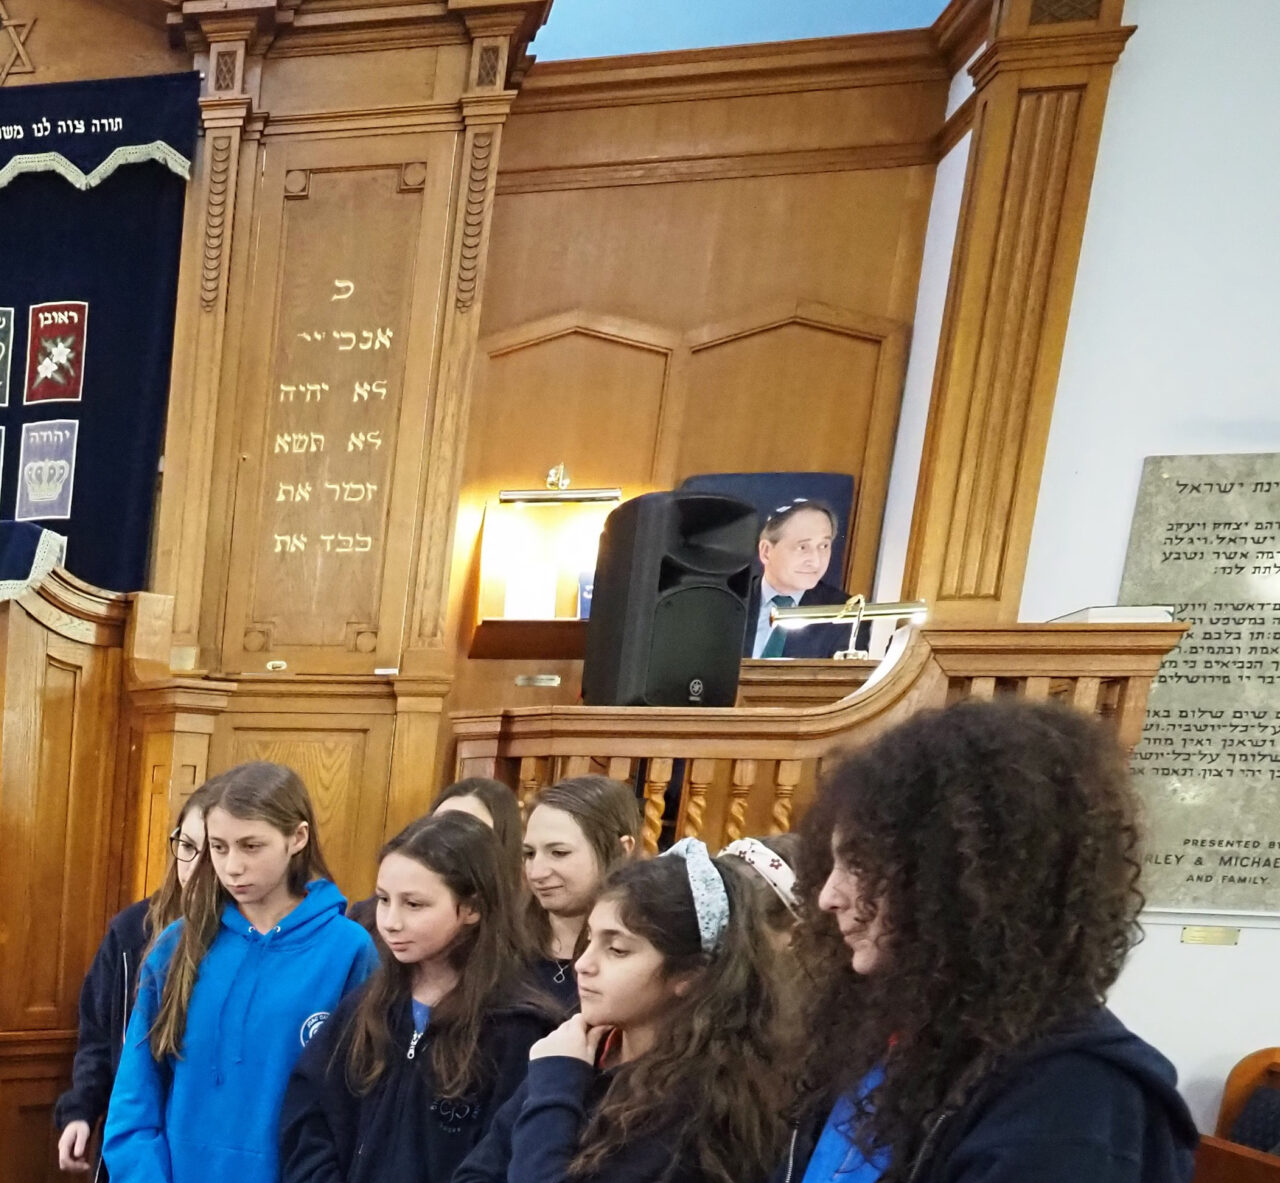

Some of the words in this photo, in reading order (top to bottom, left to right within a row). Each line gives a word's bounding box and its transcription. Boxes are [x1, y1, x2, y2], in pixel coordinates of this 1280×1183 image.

[32, 116, 52, 138] לנו
[58, 119, 85, 135] צוה
[91, 116, 123, 133] תורה
[39, 310, 79, 328] ראובן
[333, 328, 393, 350] אנכי
[280, 382, 329, 402] יהיה
[353, 381, 387, 402] לא
[30, 430, 70, 443] יהודה
[275, 432, 325, 454] תשא
[348, 431, 382, 453] לא
[276, 482, 311, 502] את
[1176, 480, 1243, 494] ישראל
[1252, 482, 1280, 493] ינת
[1166, 522, 1206, 533] ויעקב
[1213, 522, 1248, 531] יצחק
[274, 534, 307, 552] את
[320, 534, 372, 552] כבד
[1161, 552, 1204, 563] נשבע
[1213, 552, 1249, 560] אשר
[1177, 603, 1206, 614] ויוע
[1178, 708, 1224, 718] שלום
[1183, 839, 1261, 848] PRESENTED
[1143, 854, 1185, 865] RLEY
[1194, 857, 1203, 866] &
[1218, 856, 1280, 868] MICHAE
[1186, 874, 1213, 882] AND
